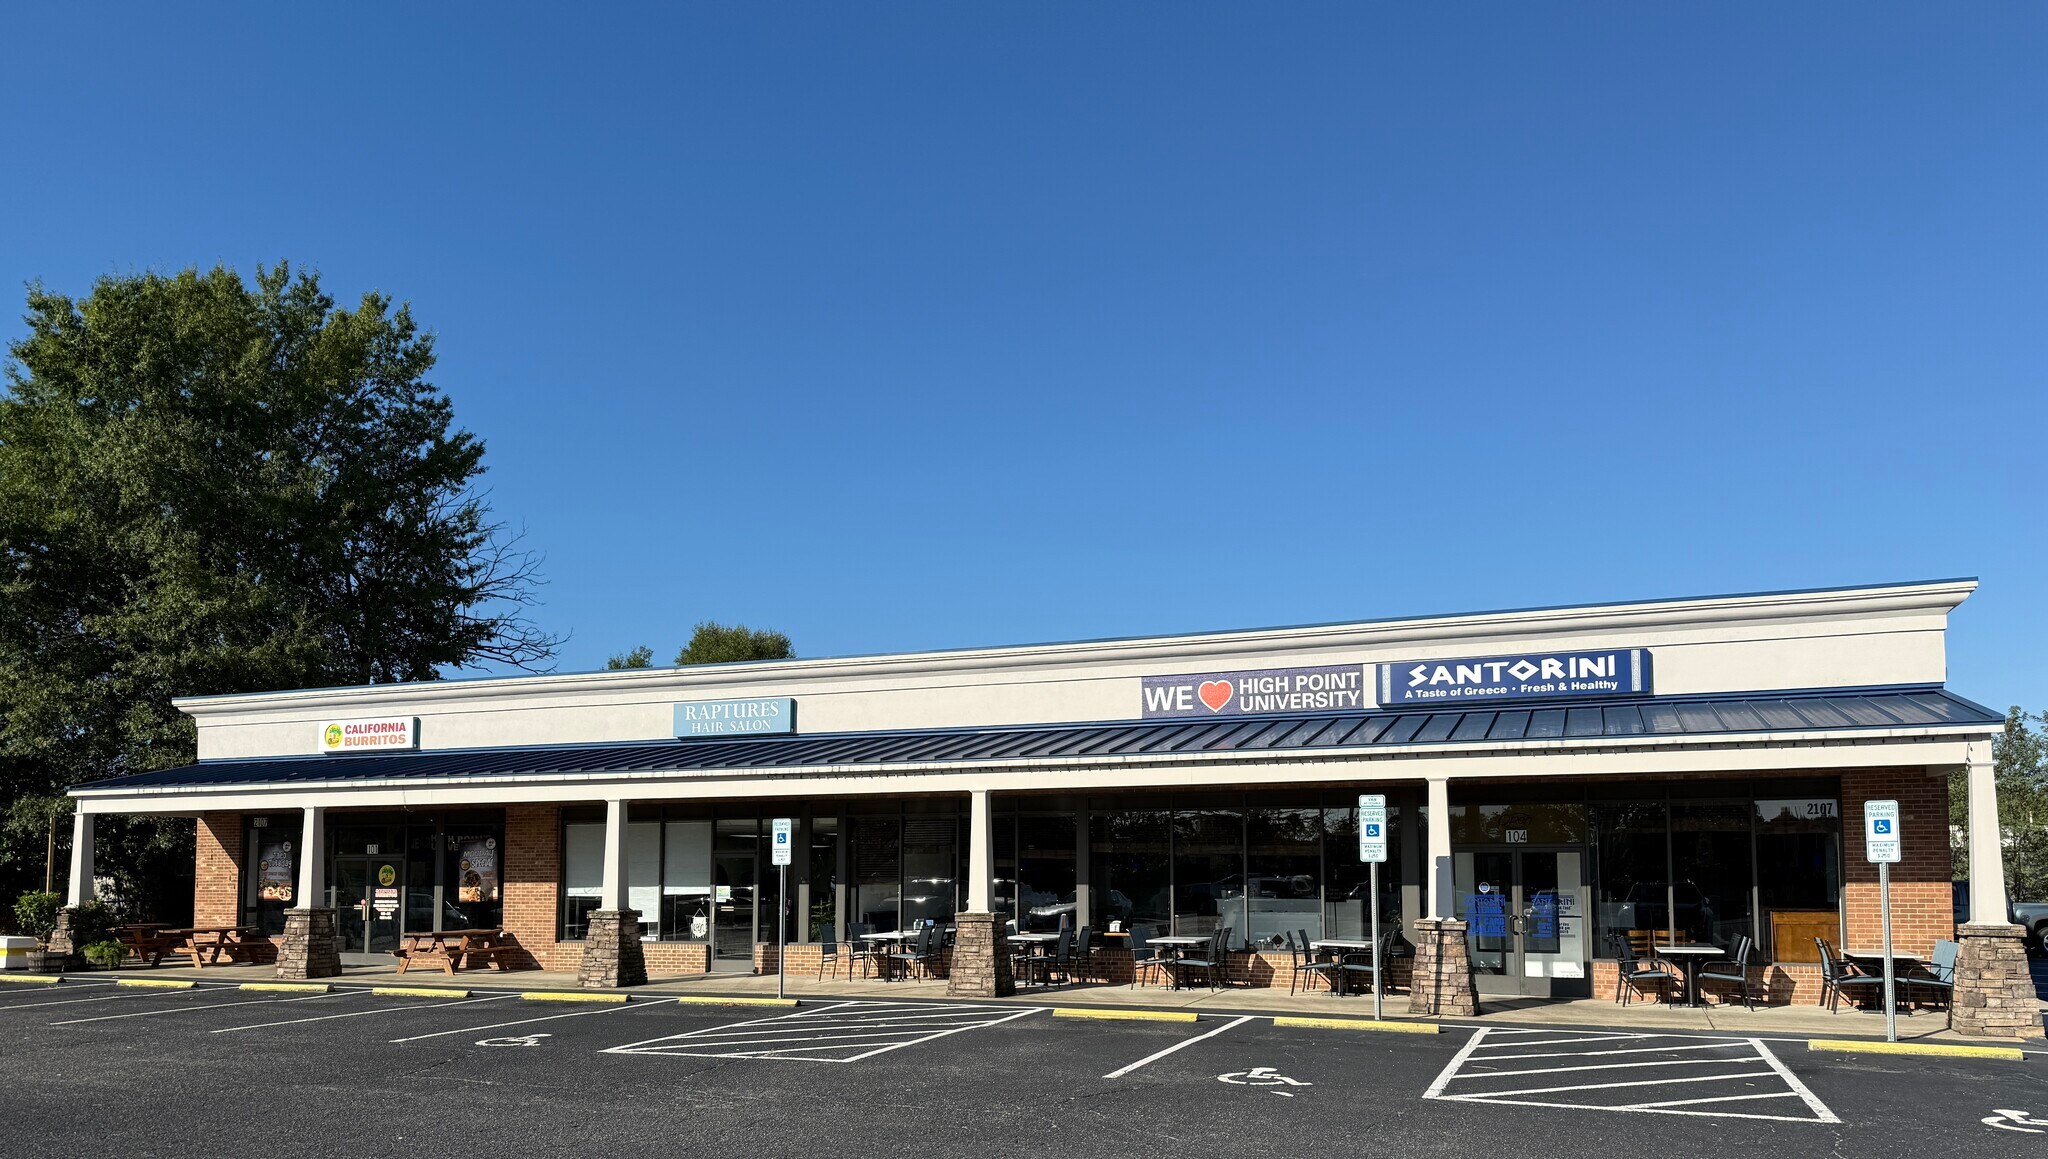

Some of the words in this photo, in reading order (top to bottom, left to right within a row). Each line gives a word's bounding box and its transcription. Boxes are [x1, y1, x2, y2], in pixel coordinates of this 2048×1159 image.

[1408, 654, 1616, 688] SANTORINI
[1144, 685, 1193, 712] WE
[1239, 676, 1289, 694] HIGH
[1295, 672, 1360, 691] POINT
[1405, 690, 1413, 699] A
[1416, 688, 1447, 698] Taste
[1450, 687, 1462, 697] of
[1464, 685, 1508, 696] Greece
[1521, 683, 1555, 693] Fresh
[1558, 682, 1567, 691] &
[1571, 680, 1619, 692] Healthy
[1239, 690, 1361, 712] UNIVERSITY
[685, 701, 779, 720] RAPTURES
[345, 722, 406, 735] CALIFORNIA
[691, 721, 724, 733] HAIR
[730, 720, 771, 732] SALON
[344, 734, 406, 746] BURRITOS
[1807, 803, 1833, 815] 2107
[1507, 830, 1527, 842] 104
[368, 844, 378, 854] 101
[463, 849, 494, 859] MONDAY
